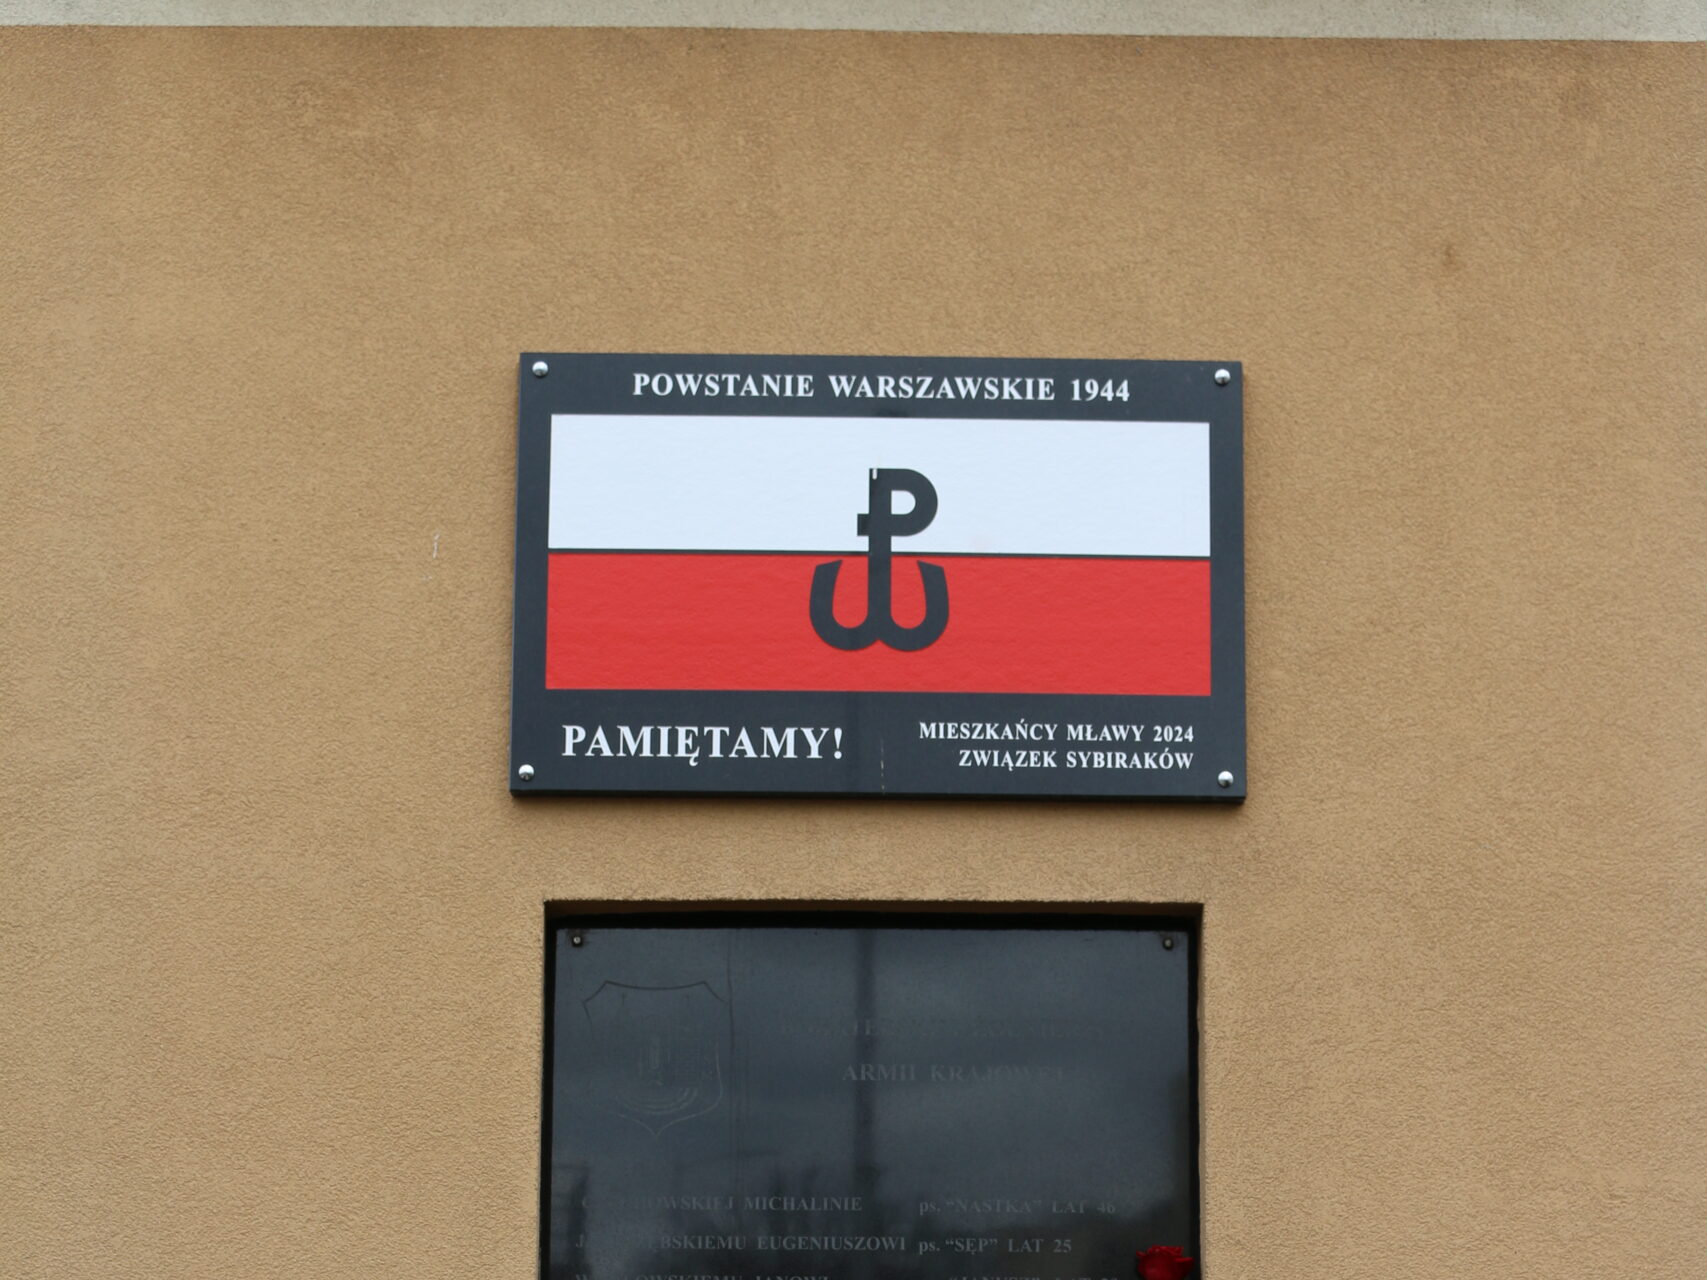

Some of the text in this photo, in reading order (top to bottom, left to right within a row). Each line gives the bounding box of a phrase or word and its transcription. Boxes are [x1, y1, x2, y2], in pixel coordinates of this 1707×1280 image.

[632, 372, 1131, 402] POWSTANIE WARSZAWSKIE 1944
[919, 718, 1195, 743] MIESZKAŃCY MŁAWY 2024
[561, 724, 845, 767] PAMIĘTAMY!
[958, 746, 1194, 772] ZWIĄZEK SYBIRAKÓW
[744, 1195, 863, 1212] MICHALINIE
[918, 1201, 941, 1217] ps.
[757, 1235, 906, 1251] EUGENIUSZOWI
[917, 1240, 940, 1256] ps.
[1007, 1238, 1045, 1253] LAT
[1053, 1238, 1073, 1253] 25
